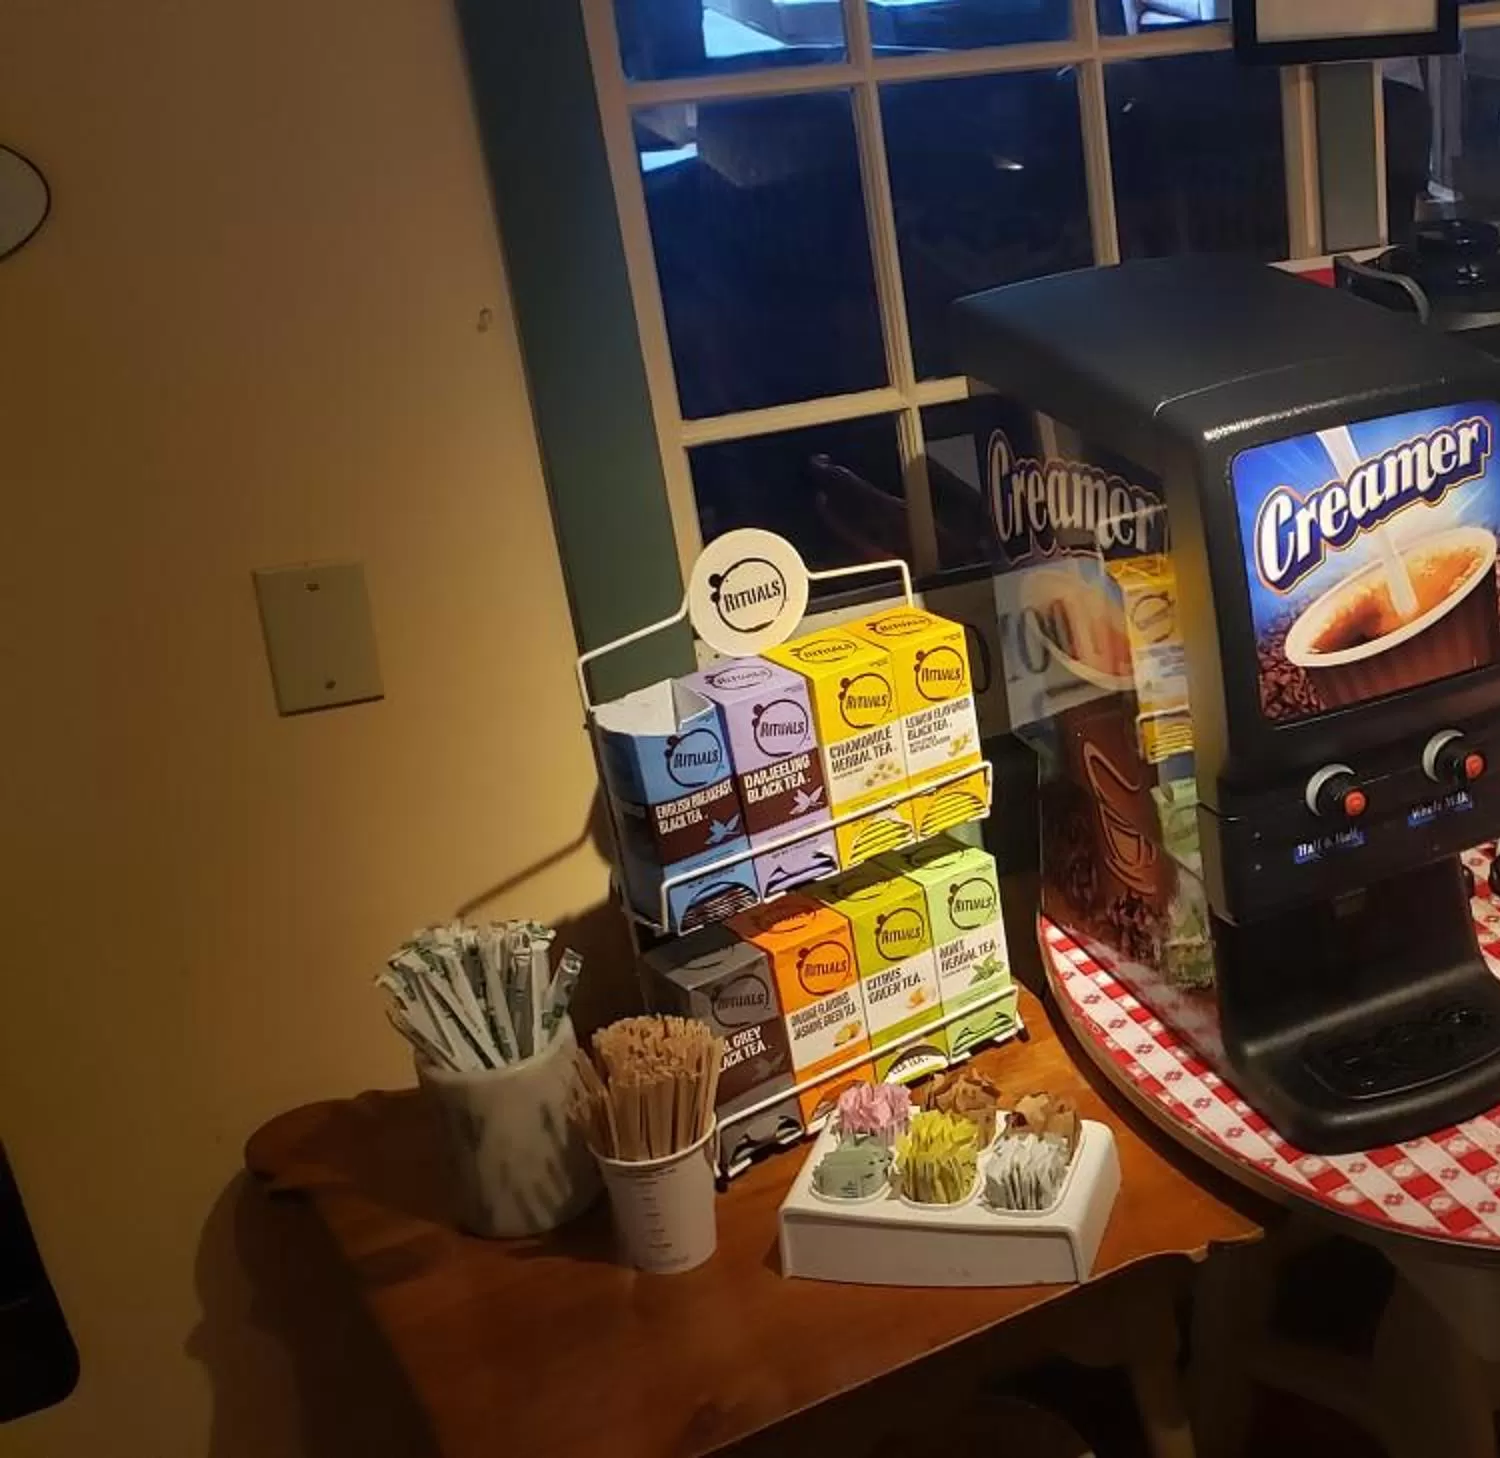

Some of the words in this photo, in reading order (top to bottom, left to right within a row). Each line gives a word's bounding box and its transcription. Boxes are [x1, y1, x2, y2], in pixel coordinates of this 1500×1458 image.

[988, 428, 1160, 553] Creamer
[1256, 416, 1489, 590] Creamer
[723, 580, 781, 613] RITUALS
[921, 666, 961, 683] RITUALS
[845, 693, 888, 710] RITUALS
[760, 721, 805, 738] RITUALS
[829, 726, 893, 759] CHAMOMILE
[673, 749, 719, 769] RITUALS
[831, 750, 872, 774] HERBAL
[744, 755, 811, 789] DARJEELING
[747, 777, 785, 805] BLACK
[658, 814, 687, 836] BLACK
[953, 898, 993, 913] RITUALS
[881, 927, 921, 945] RITUALS
[804, 960, 847, 978] RITUALS
[941, 949, 977, 973] HERBAL
[866, 967, 901, 991] CITRUS
[733, 1026, 762, 1047] GREY
[719, 1046, 745, 1073] ACK
